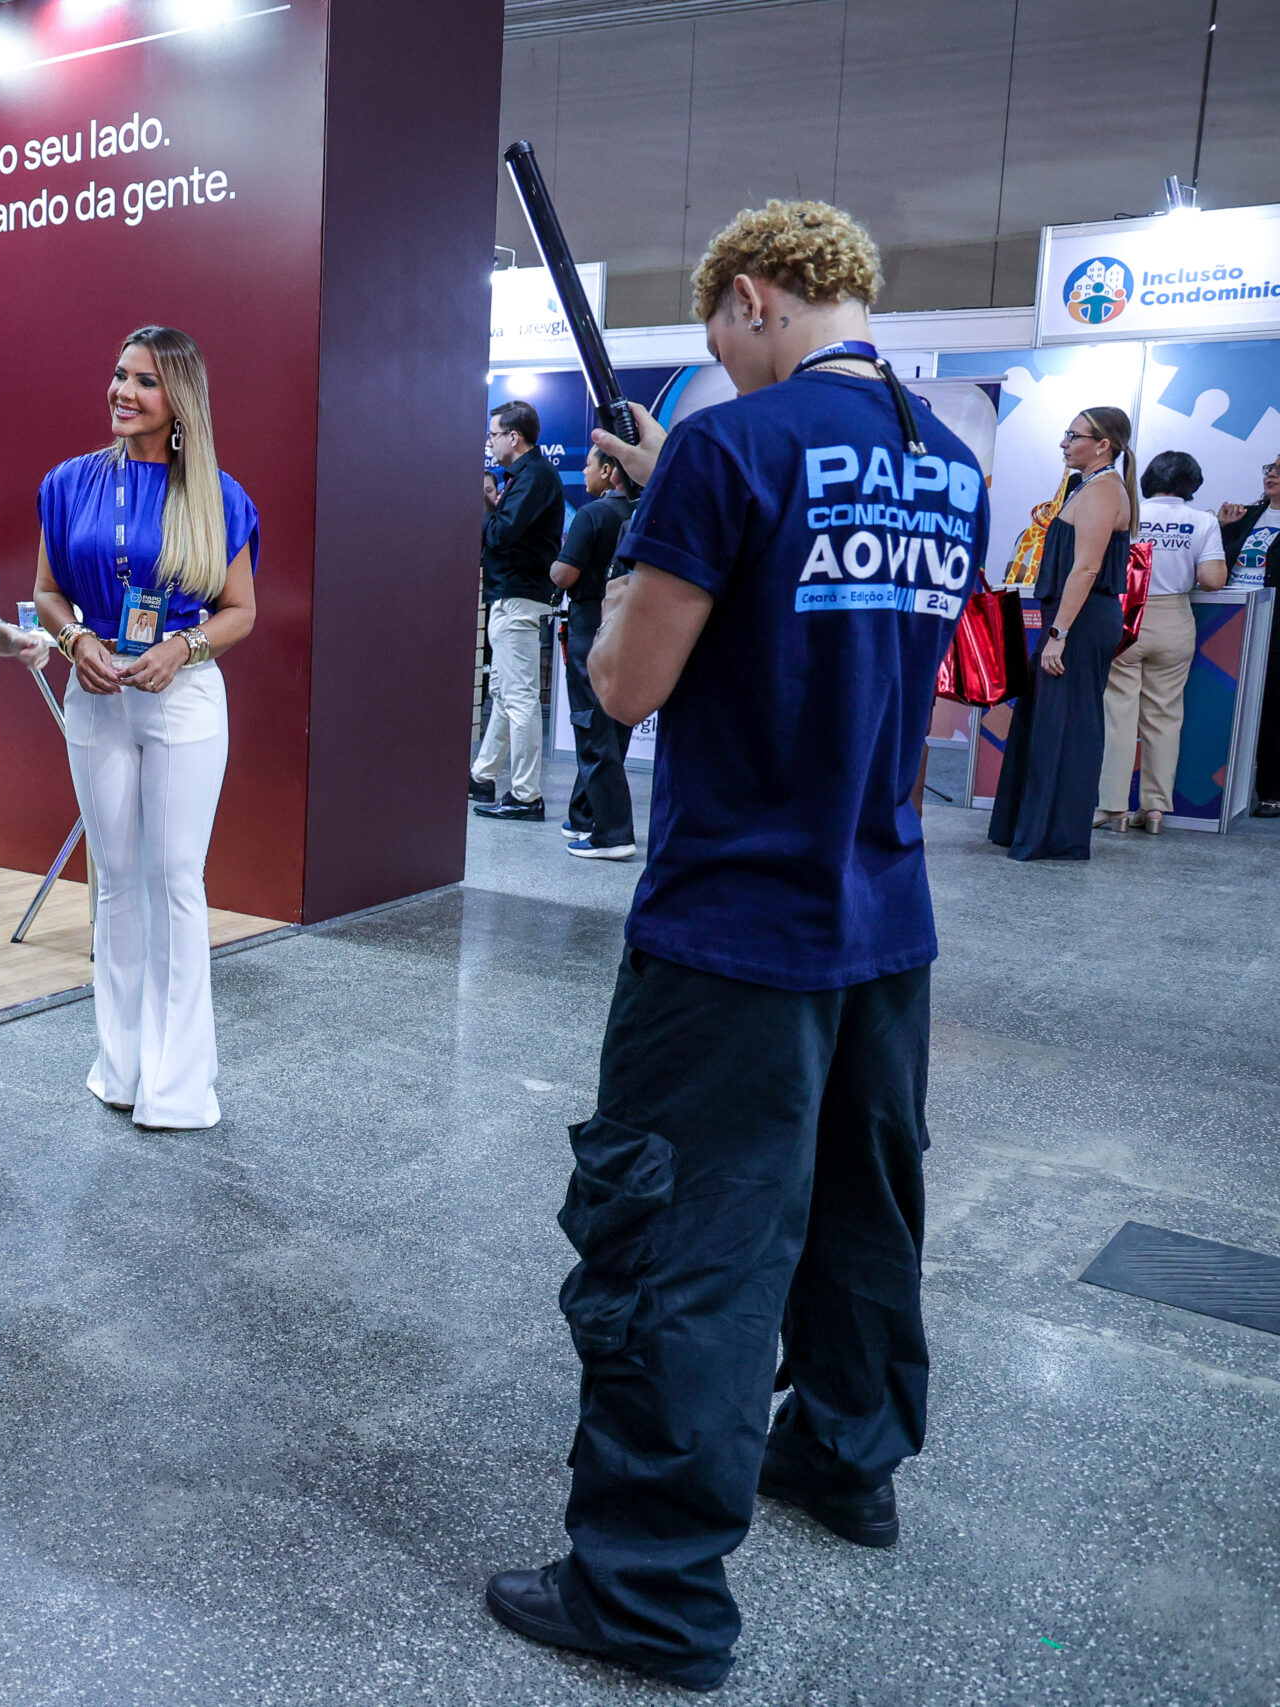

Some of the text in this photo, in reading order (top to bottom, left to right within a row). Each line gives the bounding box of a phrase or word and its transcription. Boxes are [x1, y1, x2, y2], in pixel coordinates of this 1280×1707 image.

[23, 132, 82, 171] seu
[90, 111, 170, 159] lado.
[74, 181, 116, 222] da
[123, 166, 236, 227] gente.
[1142, 263, 1244, 286] Inclusão
[799, 530, 970, 590] AO VIVO
[802, 592, 837, 604] Ceará
[850, 592, 884, 605] Edição
